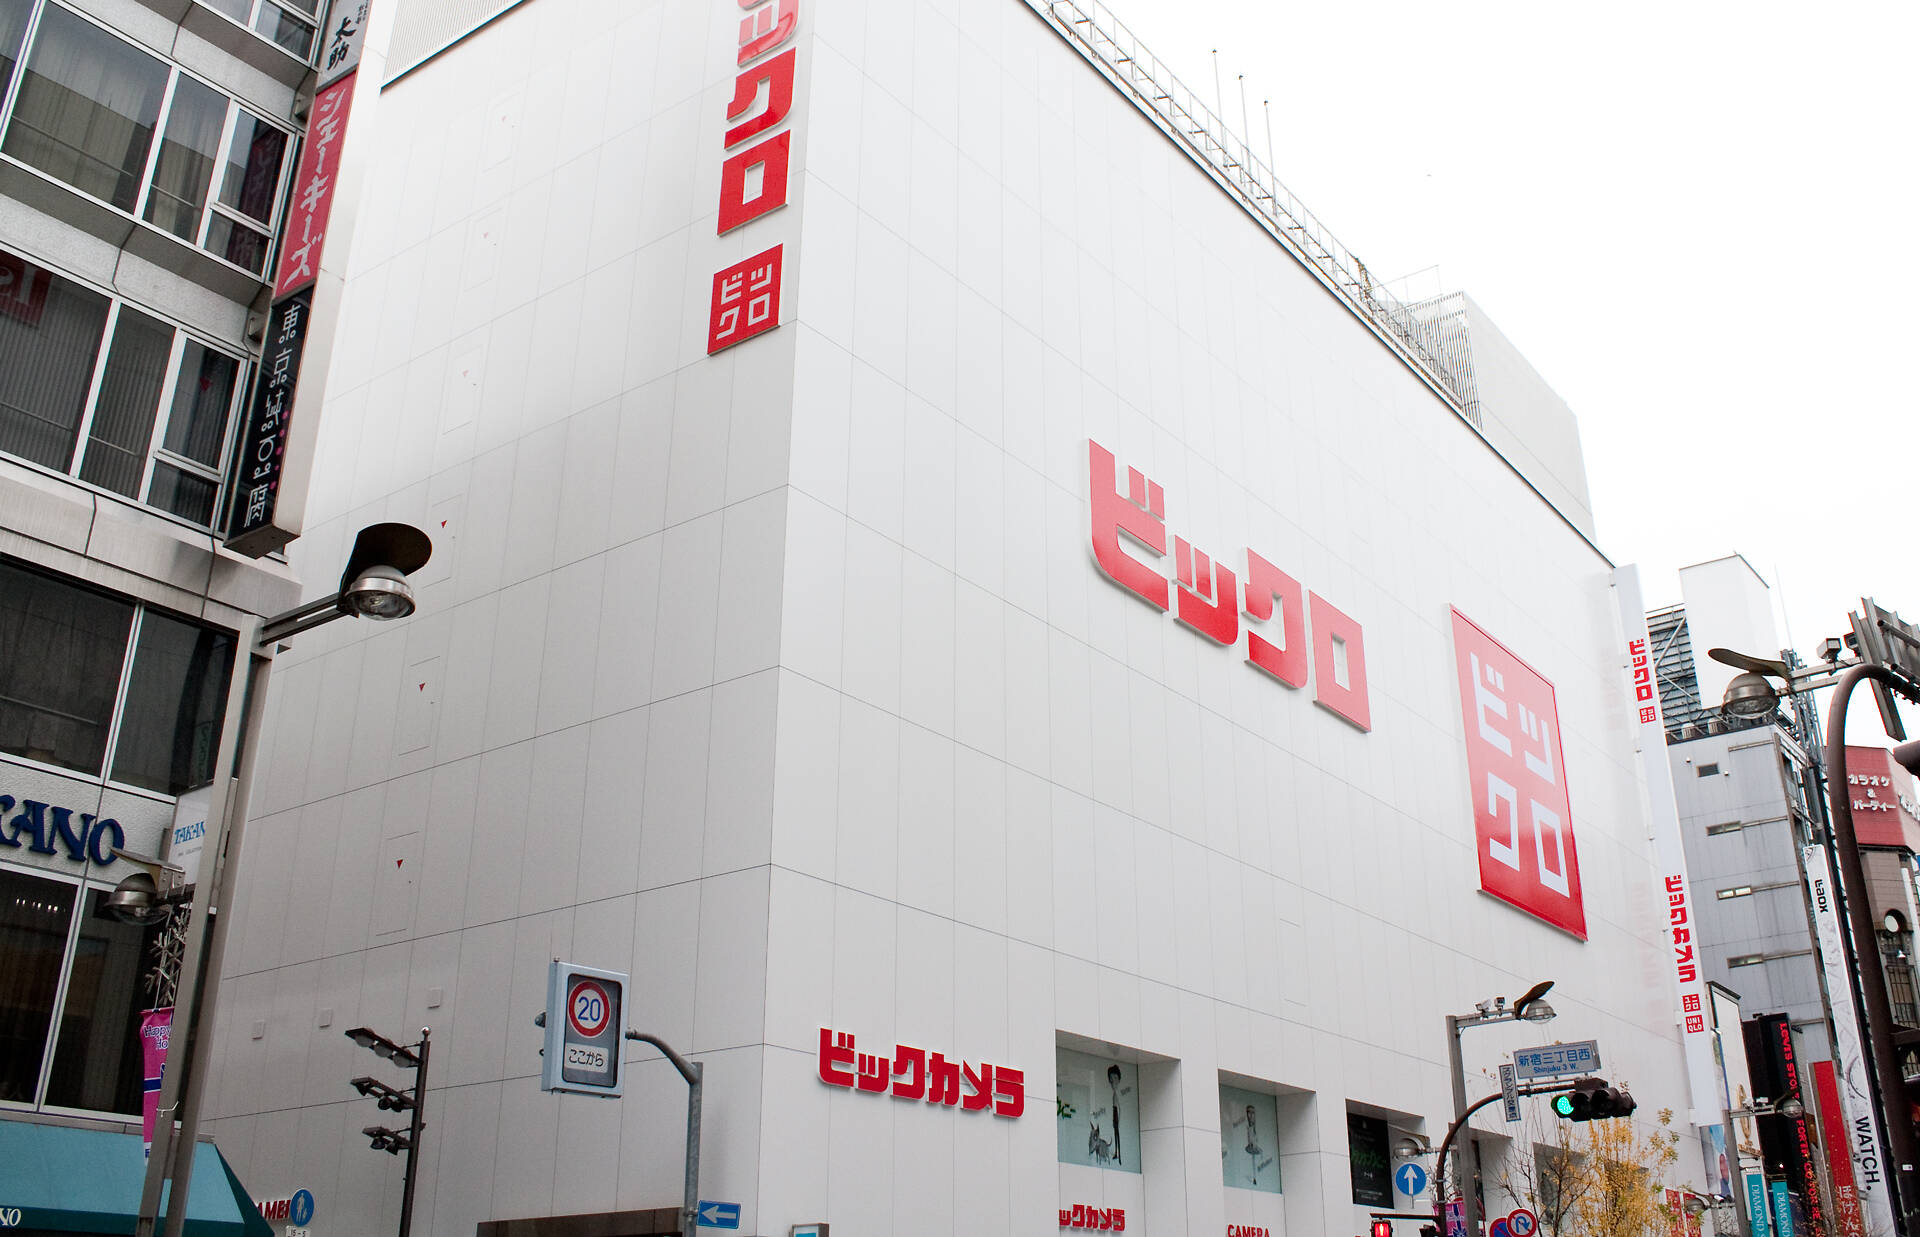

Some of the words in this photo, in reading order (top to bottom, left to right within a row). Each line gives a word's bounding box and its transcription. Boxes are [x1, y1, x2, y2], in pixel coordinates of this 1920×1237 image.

[715, 0, 799, 236] ックロ
[283, 88, 346, 289] シェーキーズ
[1089, 438, 1371, 733] ビックロ
[1629, 638, 1653, 701] ビックロ
[1848, 774, 1889, 786] カラオケ
[1867, 788, 1877, 798] &
[1854, 800, 1896, 812] パーティー
[1665, 874, 1696, 983] ビックカメラ
[578, 996, 600, 1022] 20
[568, 1049, 604, 1067] ここから
[819, 1027, 1025, 1119] ビックカメラ
[1518, 1048, 1590, 1067] 新宿三丁目西
[1533, 1065, 1560, 1074] Shinjuku
[1751, 1185, 1765, 1231] DIAMOND
